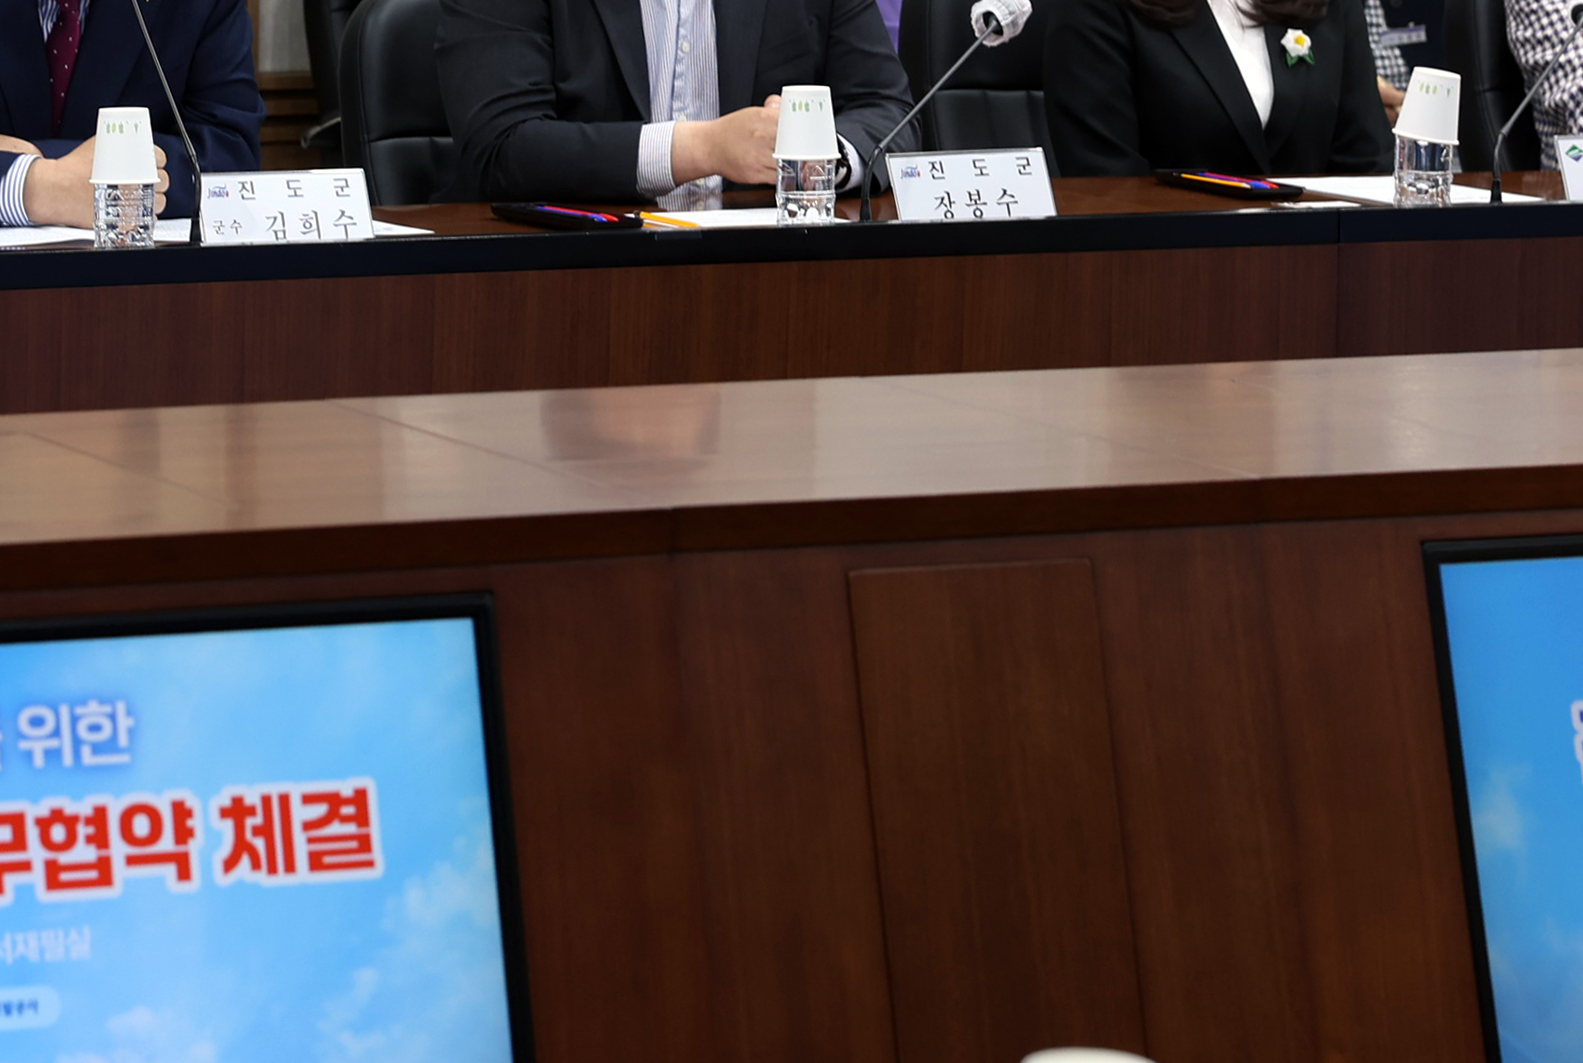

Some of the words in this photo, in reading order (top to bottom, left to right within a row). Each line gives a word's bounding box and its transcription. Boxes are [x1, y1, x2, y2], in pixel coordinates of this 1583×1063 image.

[212, 219, 244, 236] 군수
[265, 209, 357, 241] 김희수
[933, 187, 1019, 219] 장봉수
[14, 699, 135, 771] 위한
[217, 785, 378, 880] 체결
